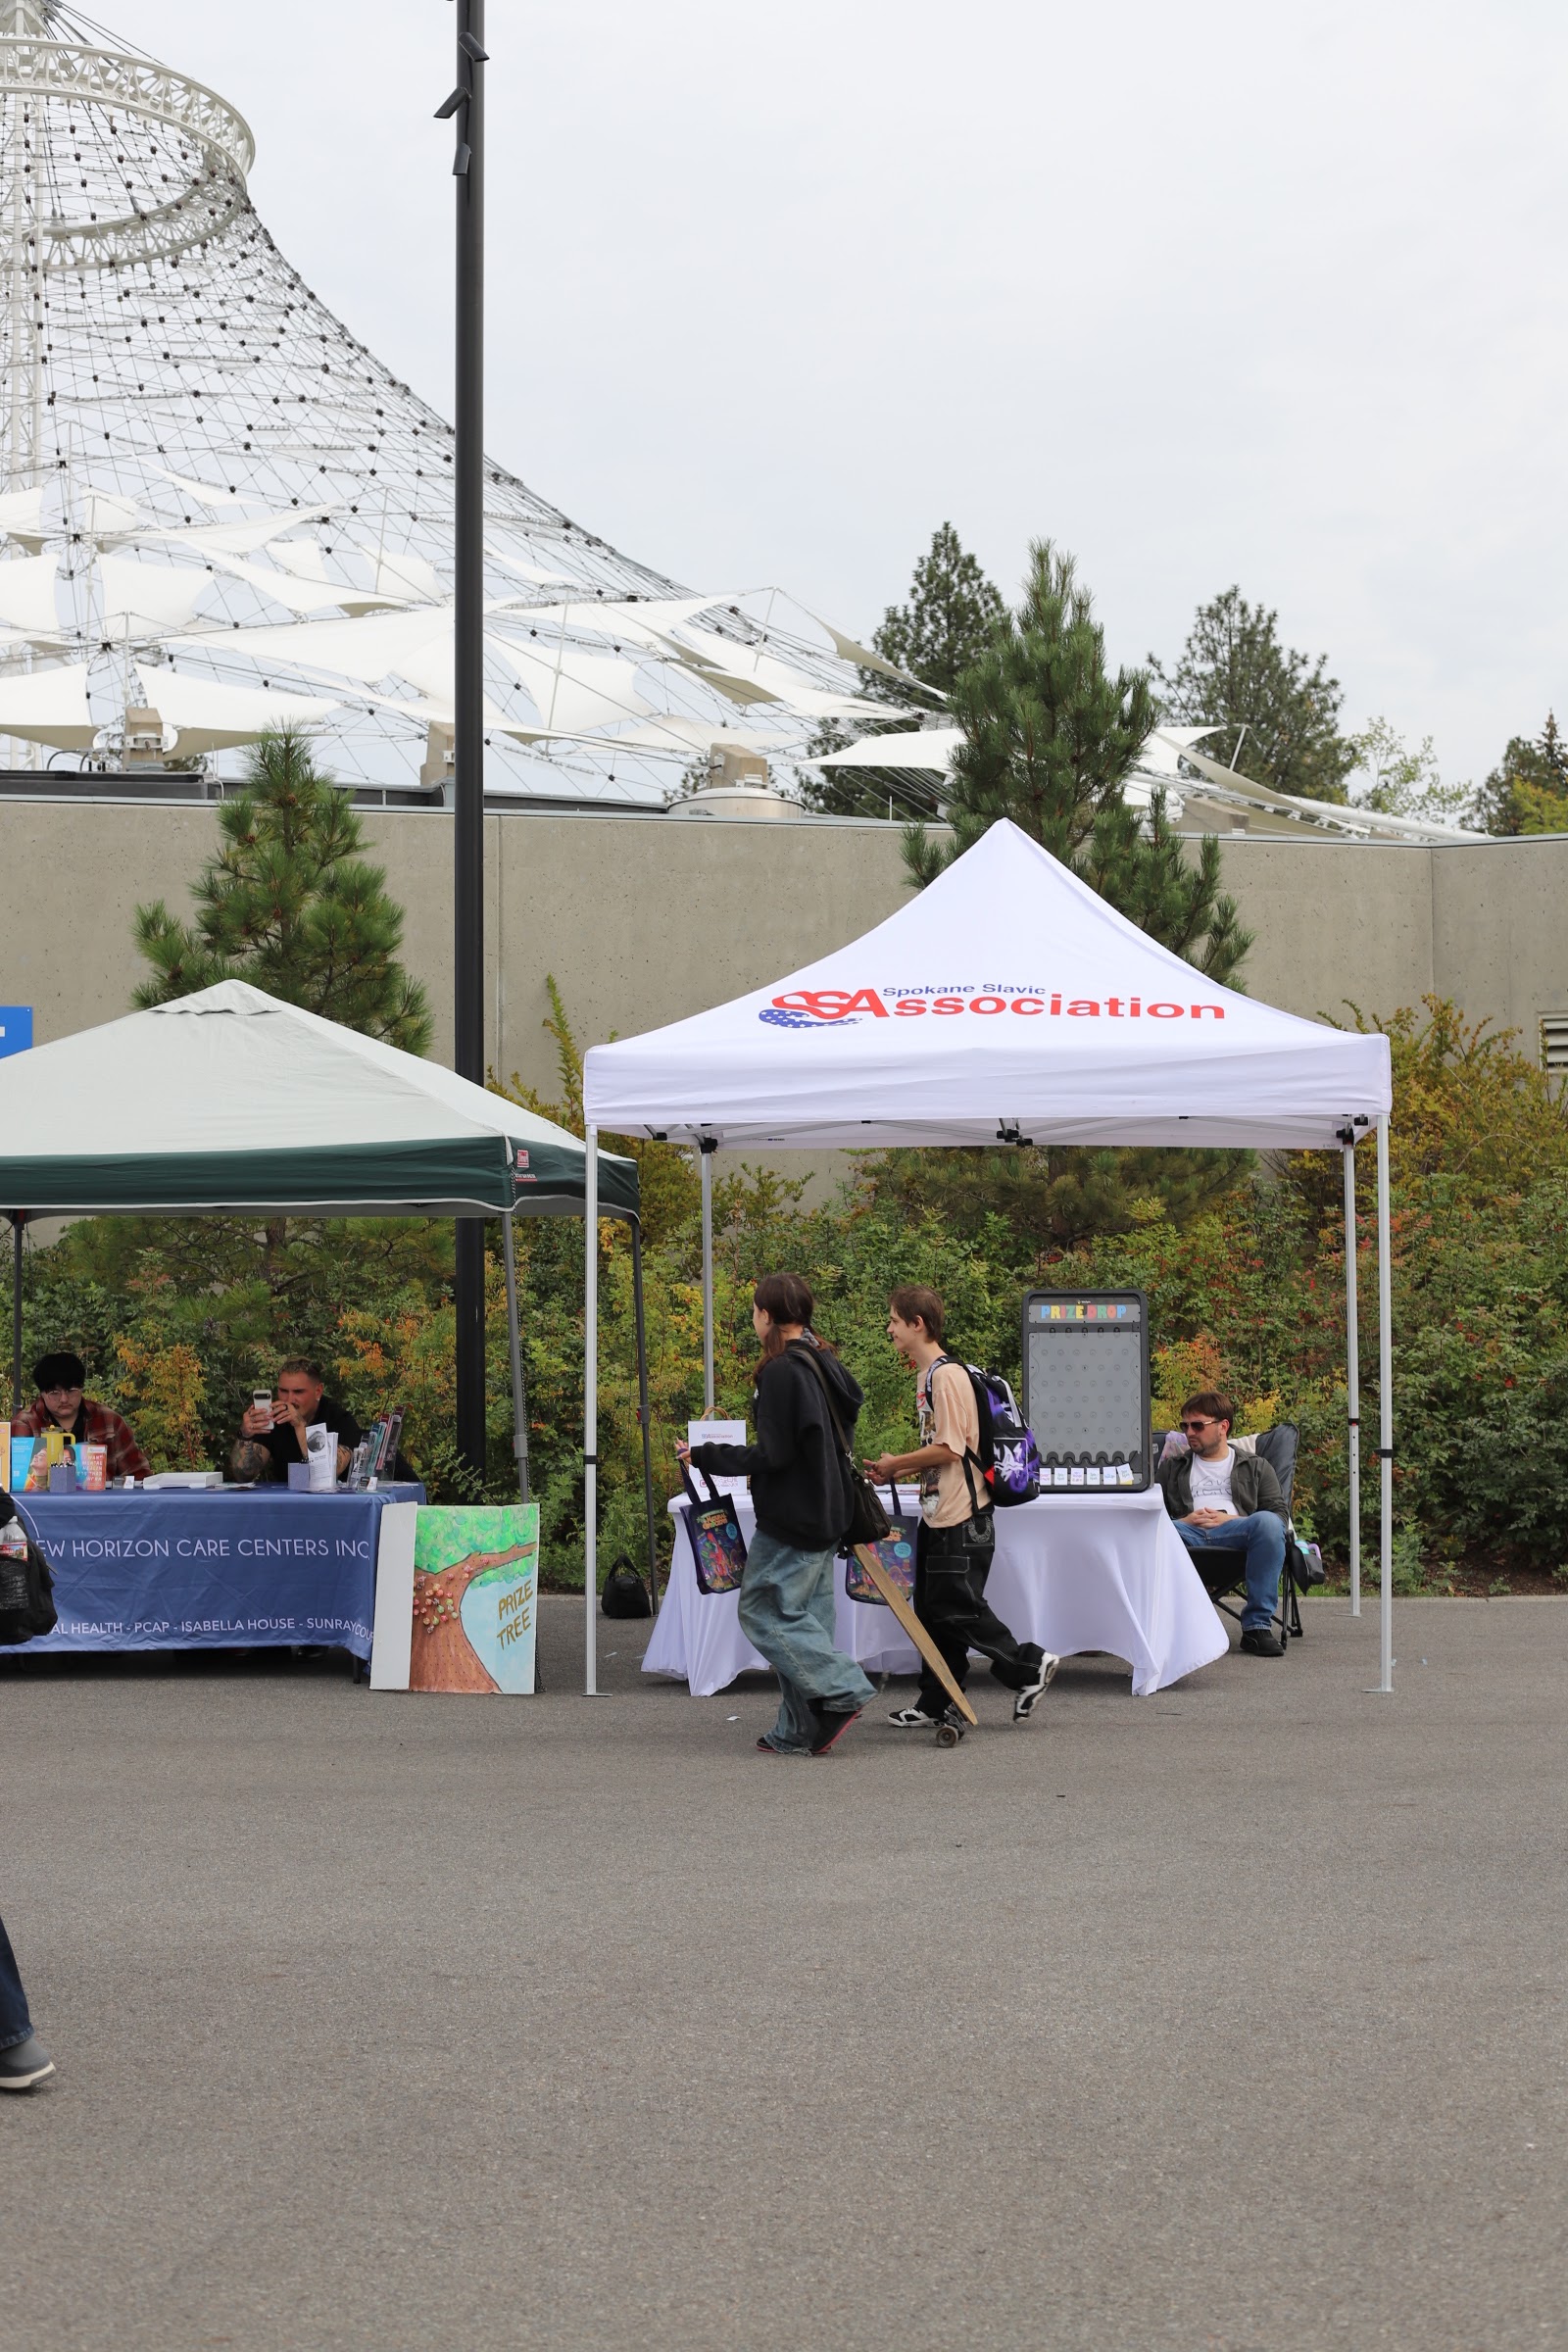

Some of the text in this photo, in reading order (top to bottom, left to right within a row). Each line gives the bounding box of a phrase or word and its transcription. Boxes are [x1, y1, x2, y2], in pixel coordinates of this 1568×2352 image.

[882, 983, 1046, 998] Spokane Slavic
[1041, 1304, 1127, 1319] PRIZE DROP
[34, 1540, 66, 1557] EW
[72, 1540, 170, 1558] HORIZON
[176, 1540, 230, 1557] CARE
[237, 1539, 329, 1556] CENTERS
[498, 1579, 533, 1621] PRIZE
[71, 1622, 122, 1635] HEALTH
[134, 1621, 170, 1633] PCAP
[181, 1619, 244, 1633] ISABELLA
[247, 1618, 295, 1631] HOUSE
[497, 1606, 531, 1650] TREE
